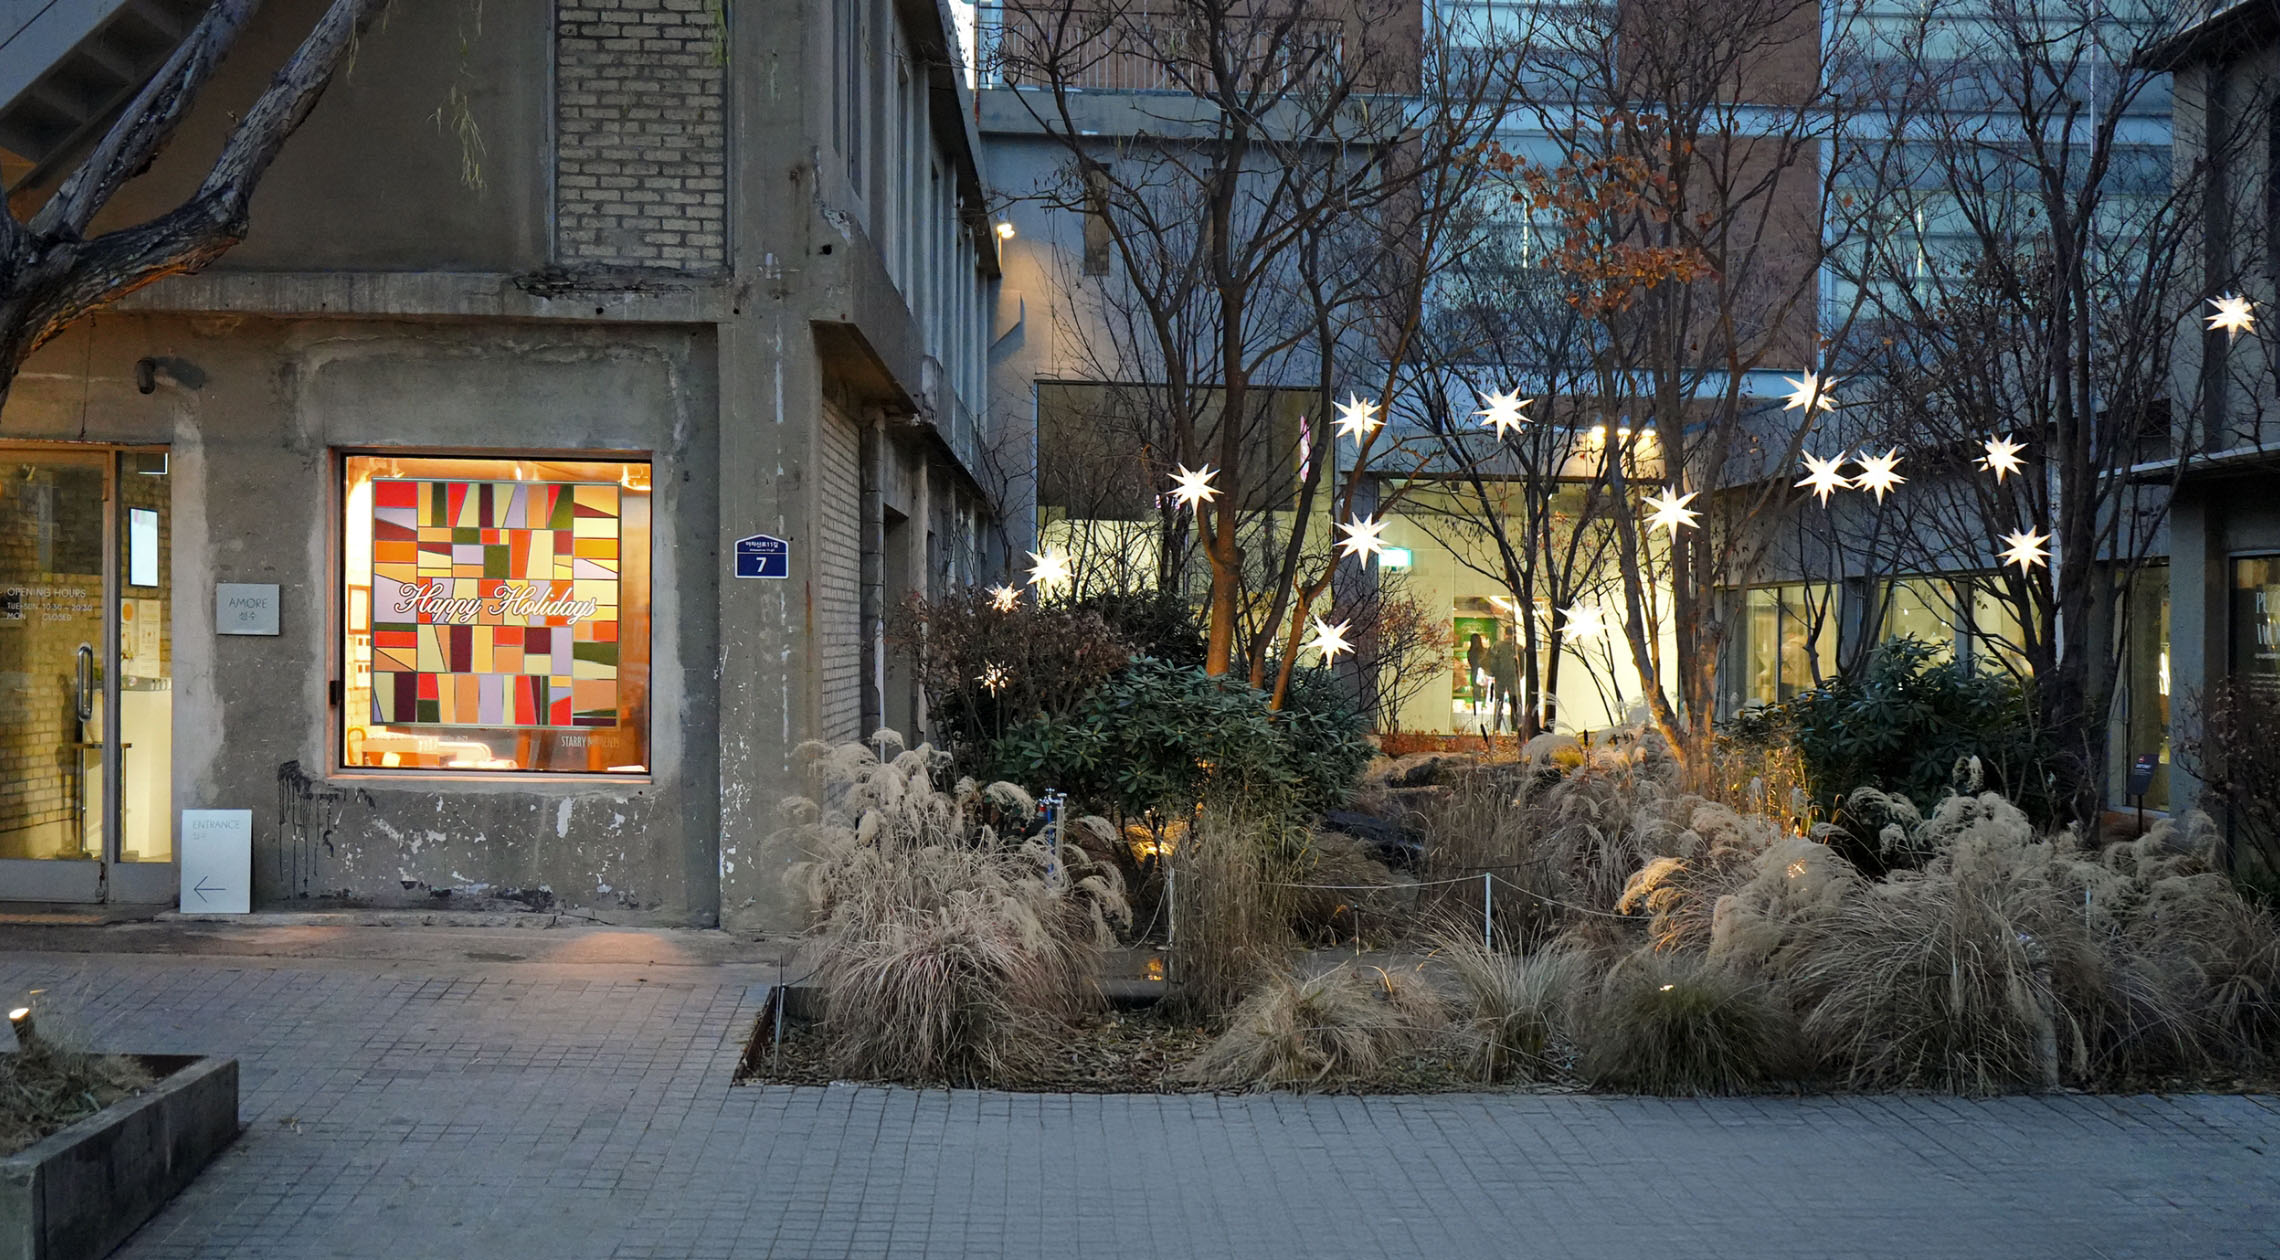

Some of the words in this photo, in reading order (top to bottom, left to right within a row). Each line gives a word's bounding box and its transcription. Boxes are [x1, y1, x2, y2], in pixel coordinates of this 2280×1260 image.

[755, 557, 767, 573] 7
[7, 587, 51, 598] OPENING
[53, 588, 87, 599] HOURS
[229, 597, 268, 609] AMORE
[394, 583, 483, 623] Happy
[488, 585, 598, 624] Holidays
[7, 612, 26, 621] MON
[42, 613, 72, 622] CLOSED
[561, 735, 586, 748] STARRY
[193, 820, 240, 831] ENTRANCE
